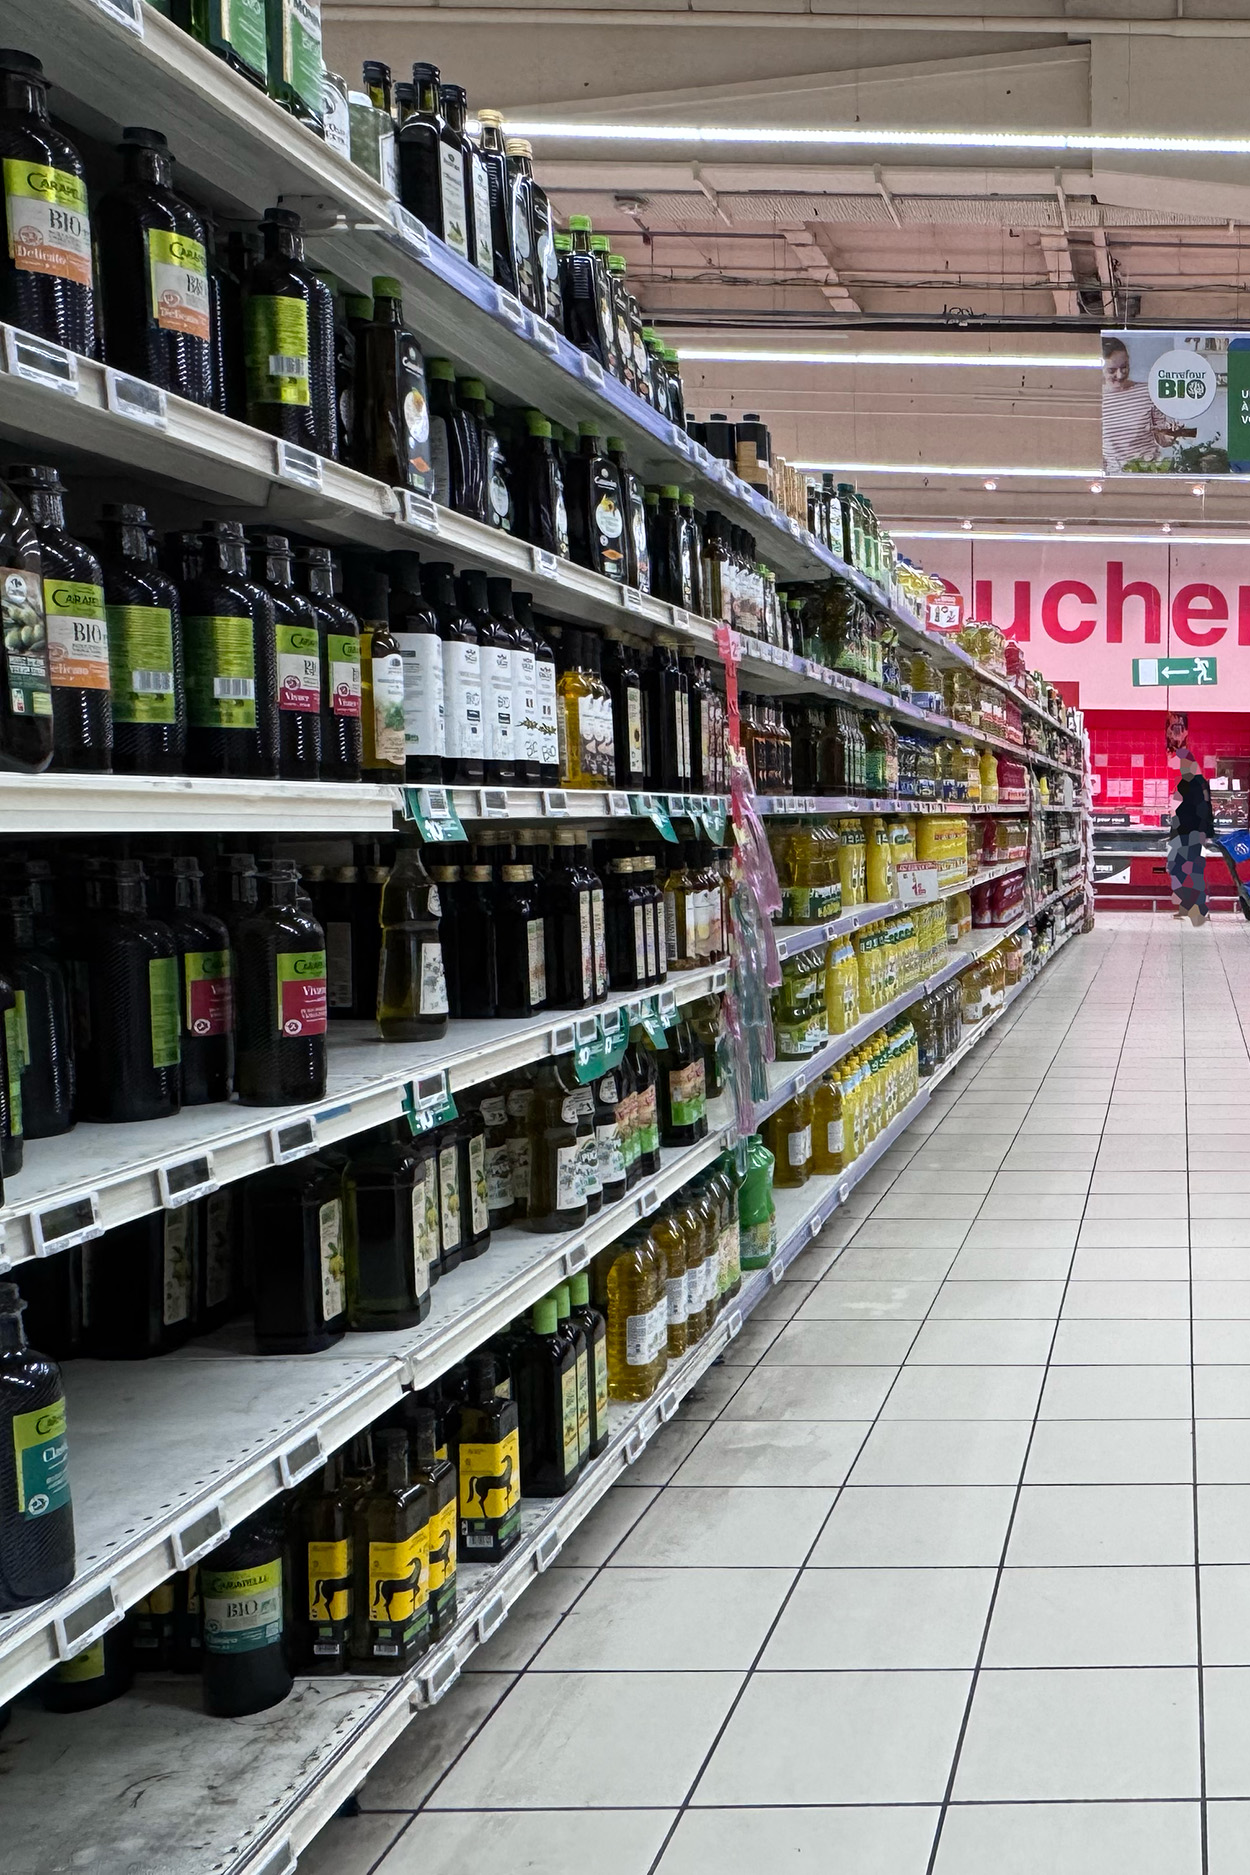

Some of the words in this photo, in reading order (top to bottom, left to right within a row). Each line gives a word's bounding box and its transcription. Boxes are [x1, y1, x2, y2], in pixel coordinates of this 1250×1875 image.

[49, 208, 81, 236] BIO
[1158, 369, 1206, 379] Carrefour
[1158, 379, 1207, 399] BIO
[1241, 400, 1249, 412] À
[73, 621, 102, 643] BIO
[227, 1600, 258, 1618] BIO
